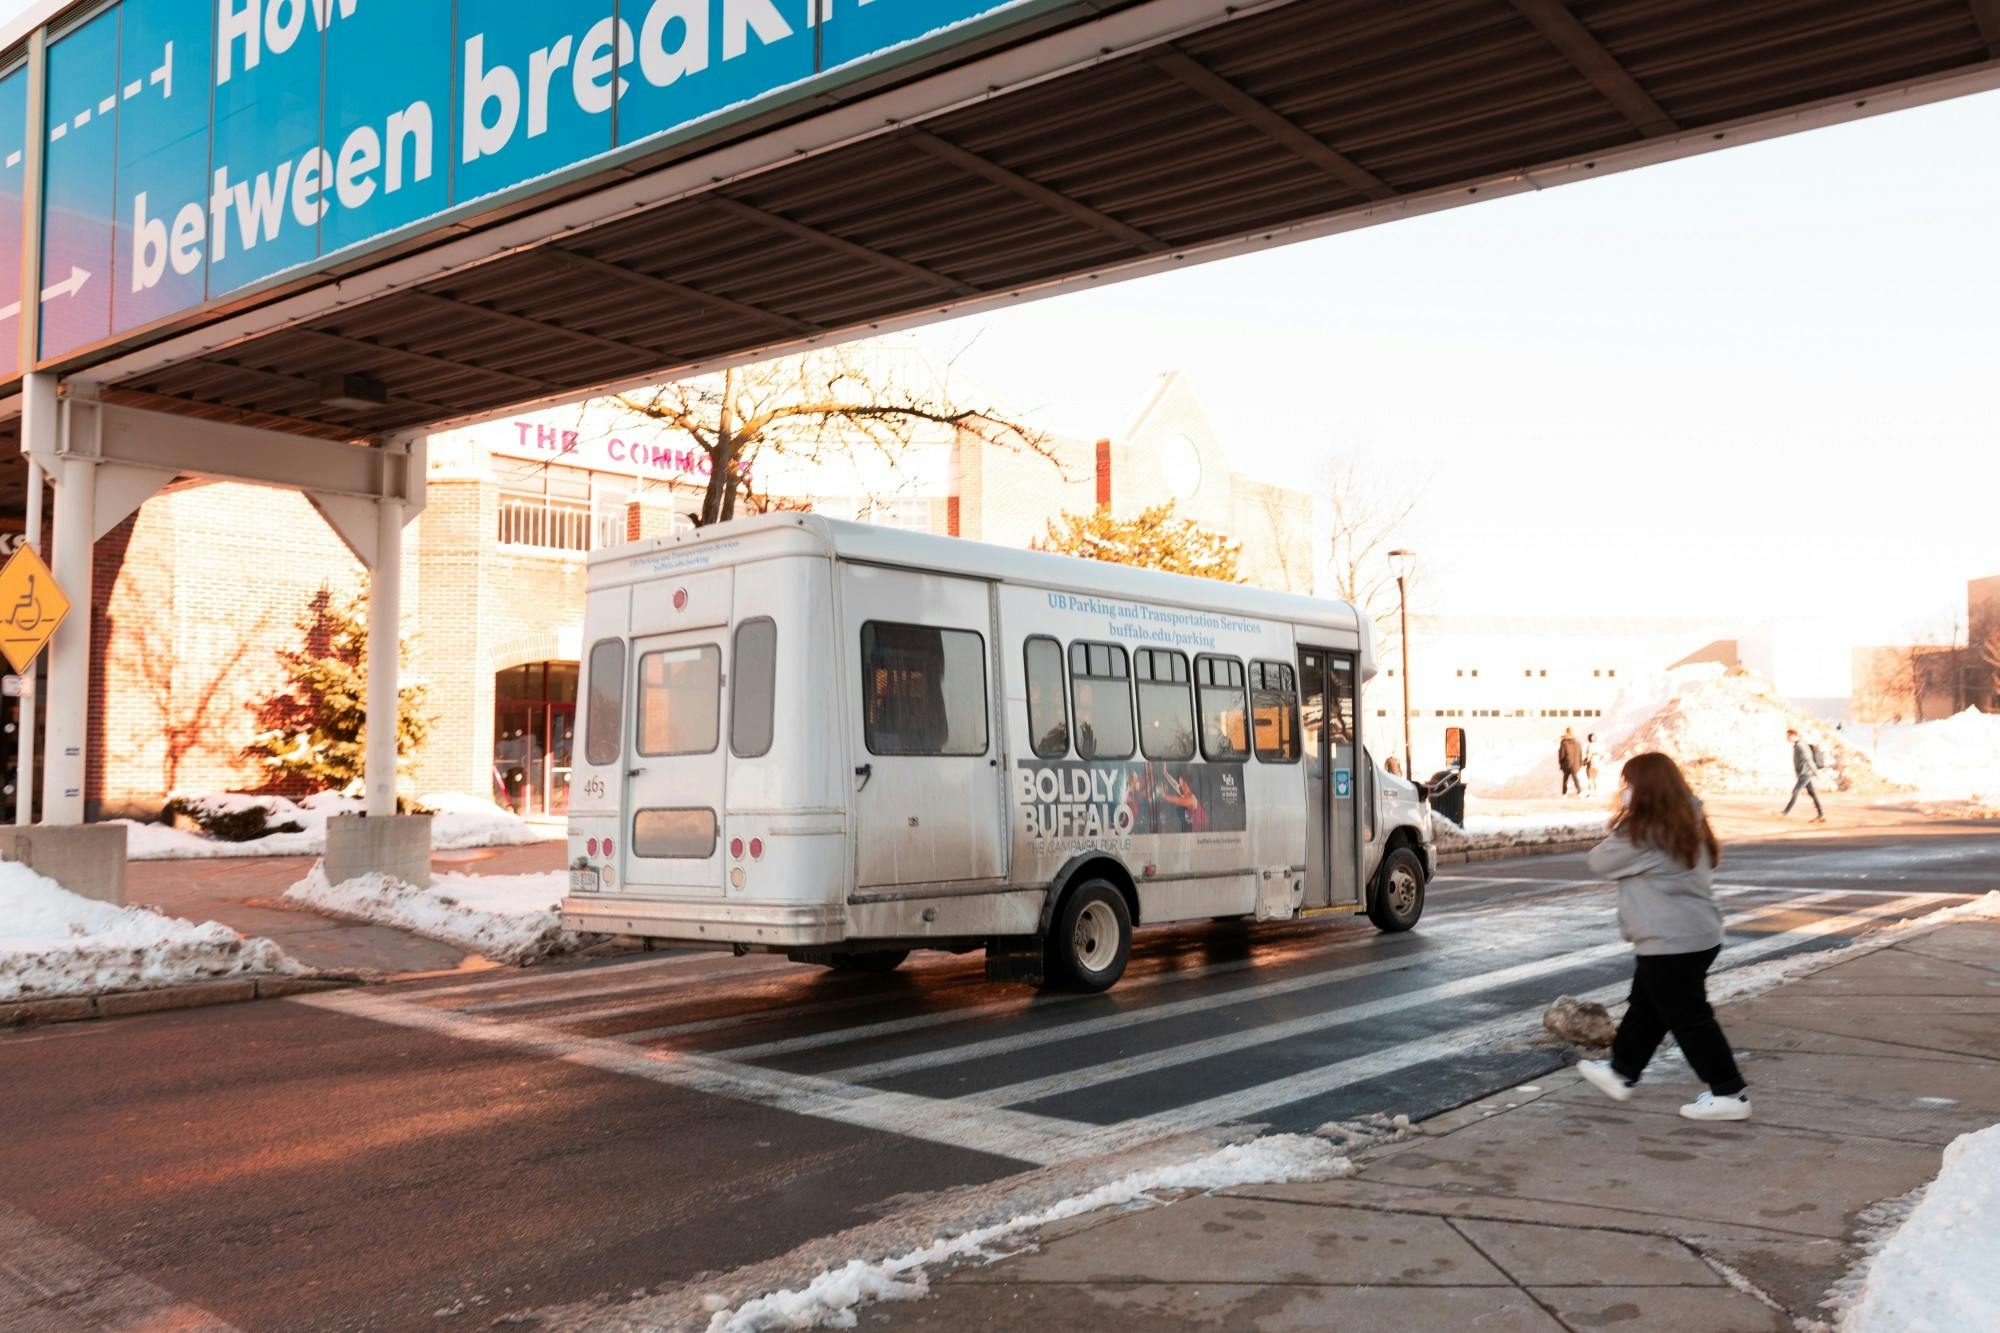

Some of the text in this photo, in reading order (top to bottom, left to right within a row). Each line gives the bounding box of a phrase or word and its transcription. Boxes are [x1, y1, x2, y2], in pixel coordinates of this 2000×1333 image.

[132, 100, 433, 294] between
[514, 421, 579, 453] THE
[1047, 593, 1261, 634] UB Parking and Transportation Services
[1108, 623, 1216, 649] buffalo.edu/parking
[584, 775, 605, 799] 463
[1018, 768, 1118, 803] BOLDLY
[1020, 803, 1134, 838] BUFFALO
